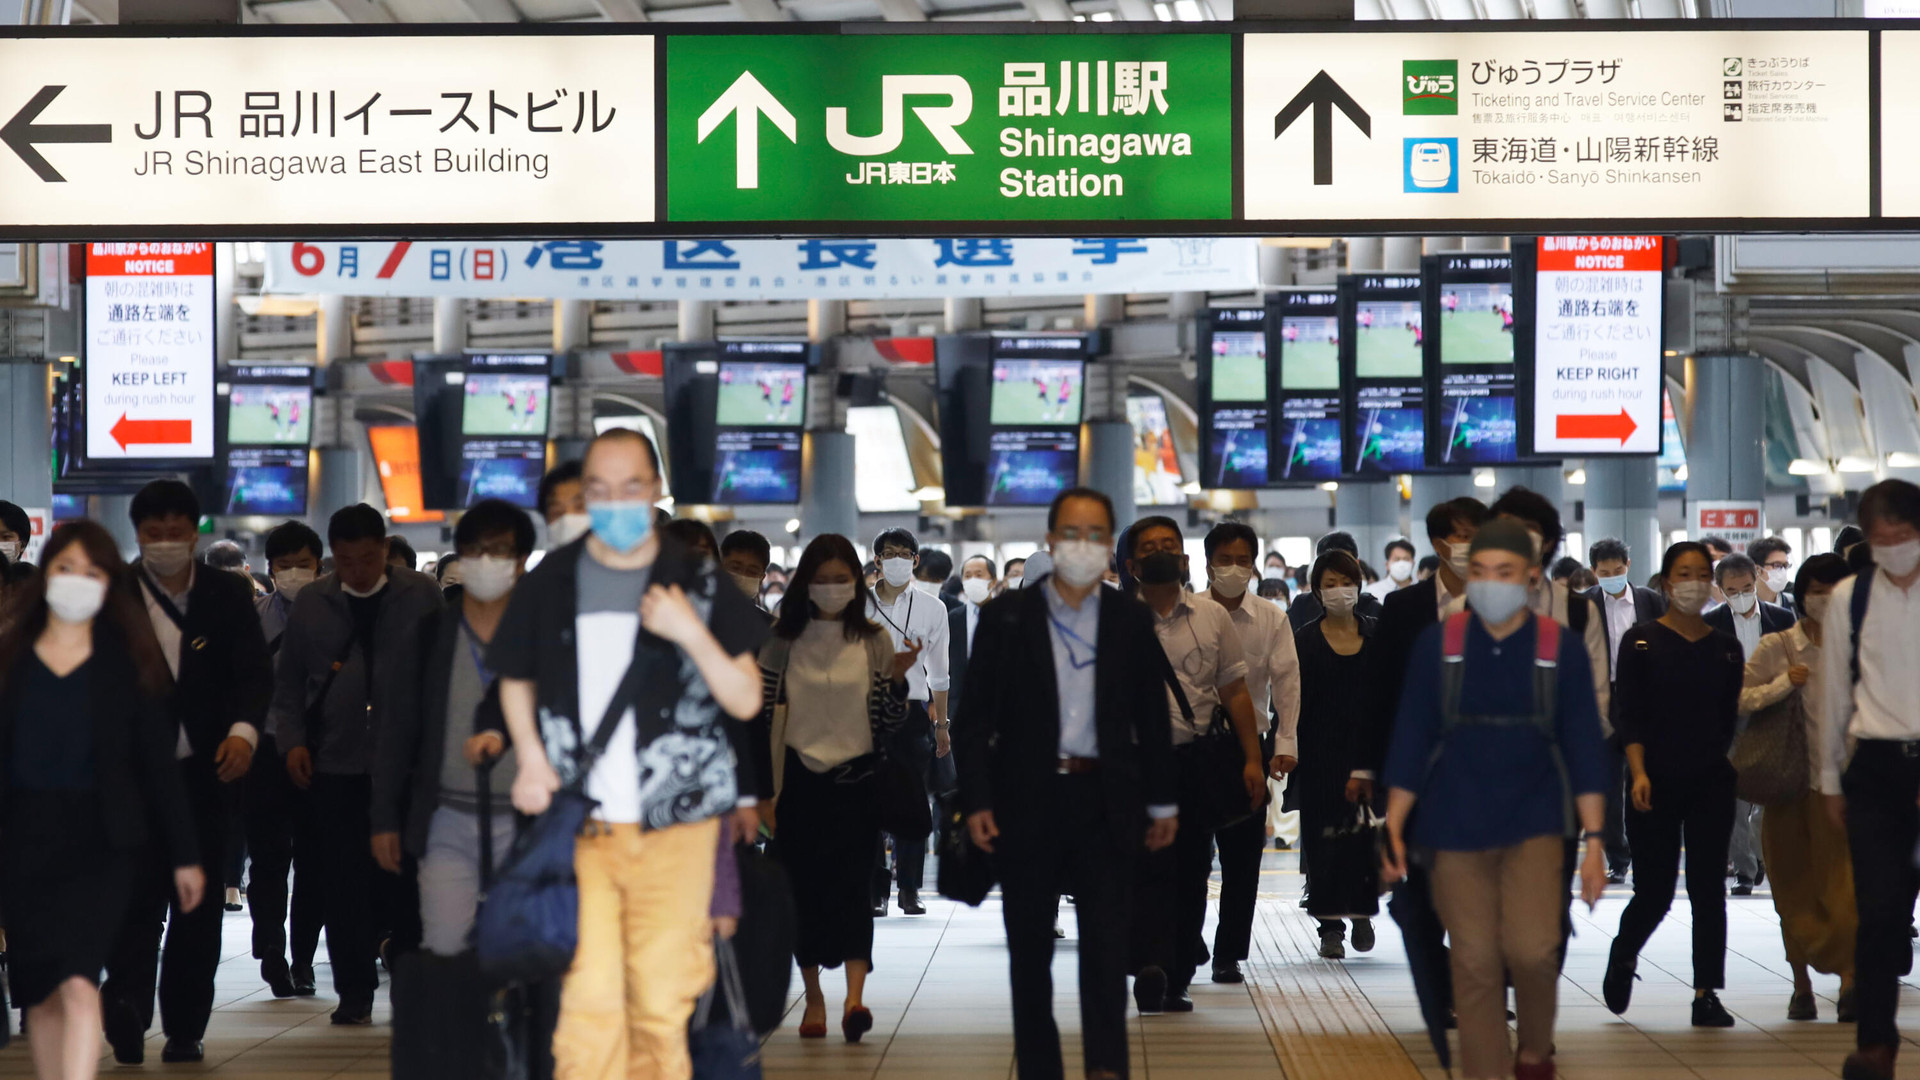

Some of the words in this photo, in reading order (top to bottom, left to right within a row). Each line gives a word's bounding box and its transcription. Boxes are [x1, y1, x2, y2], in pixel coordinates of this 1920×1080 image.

[1471, 58, 1623, 86] びゅうプラザ
[1747, 57, 1810, 69] きっぷうりば
[998, 59, 1170, 117] 品川駅
[1407, 75, 1454, 94] びゅう
[1747, 80, 1826, 92] 旅行カウンター
[1471, 92, 1531, 111] Ticketing
[1534, 92, 1560, 107] and
[1563, 91, 1603, 107] Travel
[1607, 91, 1657, 107] Service
[1661, 90, 1706, 106] Center
[1747, 102, 1818, 114] 指定席券売機
[134, 90, 214, 141] JR
[239, 87, 617, 139] 品川イーストビル
[825, 74, 975, 157] JR
[999, 126, 1193, 165] Shinagawa
[1471, 135, 1720, 164] 東海道・山陽新幹線
[134, 150, 173, 176] JR
[185, 149, 347, 182] Shinagawa
[359, 148, 423, 174] East
[434, 147, 549, 180] Building
[845, 160, 957, 185] JR東日本
[999, 166, 1124, 198] Station
[1605, 168, 1702, 184] Shinkansen
[1543, 236, 1657, 251] 品川駅からのおねがい
[124, 259, 175, 274] NOTICE
[1574, 255, 1624, 269] NOTICE
[104, 280, 195, 298] 朝の混雑時は
[1555, 275, 1643, 293] 朝の混雑時は
[108, 303, 190, 322] 通路左端を
[1557, 298, 1639, 317] 通路右端を
[97, 327, 202, 346] ご通行ください
[1546, 323, 1651, 341] ご通行ください
[130, 352, 169, 366] Please
[1579, 347, 1618, 361] Please
[112, 372, 150, 386] KEEP
[153, 372, 188, 386] LEFT
[1556, 367, 1594, 381] KEEP
[1597, 367, 1640, 381] RIGHT
[104, 392, 139, 409] during
[142, 392, 167, 406] rush
[170, 392, 197, 406] hour
[1552, 387, 1588, 403] during
[1590, 387, 1615, 400] rush
[1618, 387, 1643, 400] hour
